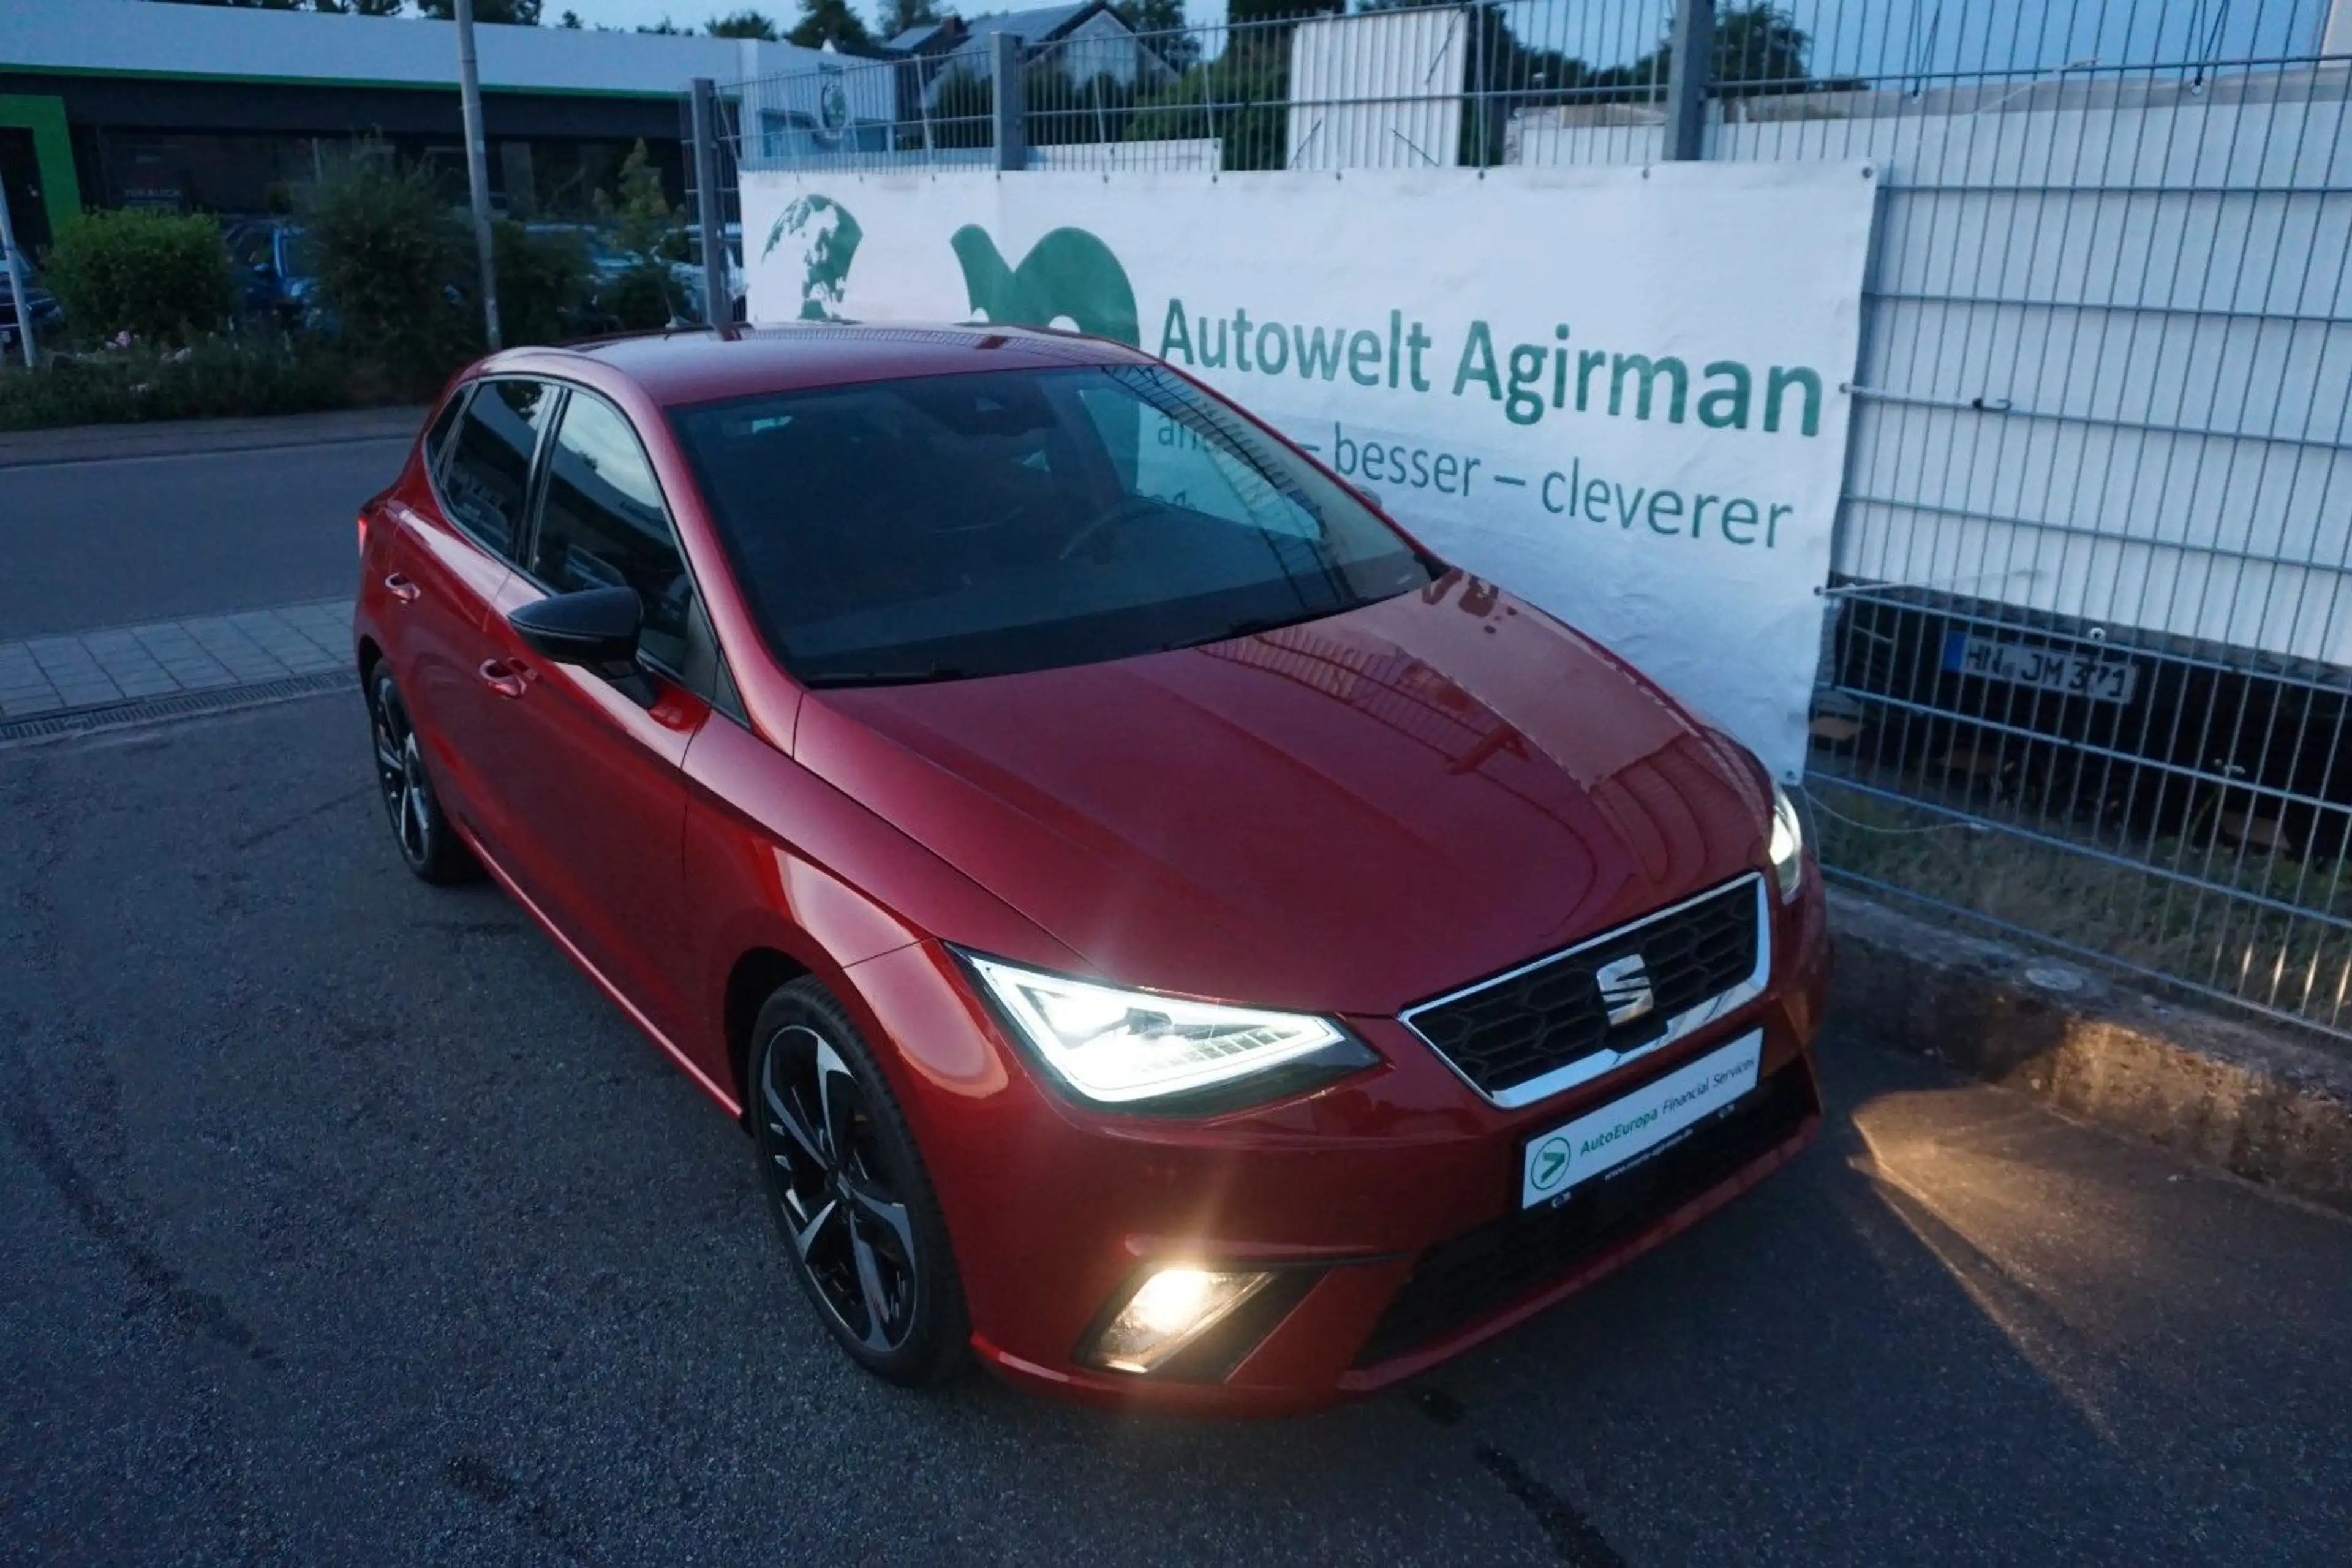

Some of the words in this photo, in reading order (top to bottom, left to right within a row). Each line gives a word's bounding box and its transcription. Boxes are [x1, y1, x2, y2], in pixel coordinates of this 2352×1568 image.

[1159, 298, 1432, 392] Autowelt
[1452, 320, 1822, 437] Agirman
[1335, 421, 1482, 497] besser
[1542, 456, 1793, 548] cleverer
[1580, 1107, 1658, 1157] AutoEuropa
[1662, 1077, 1709, 1115] Financial
